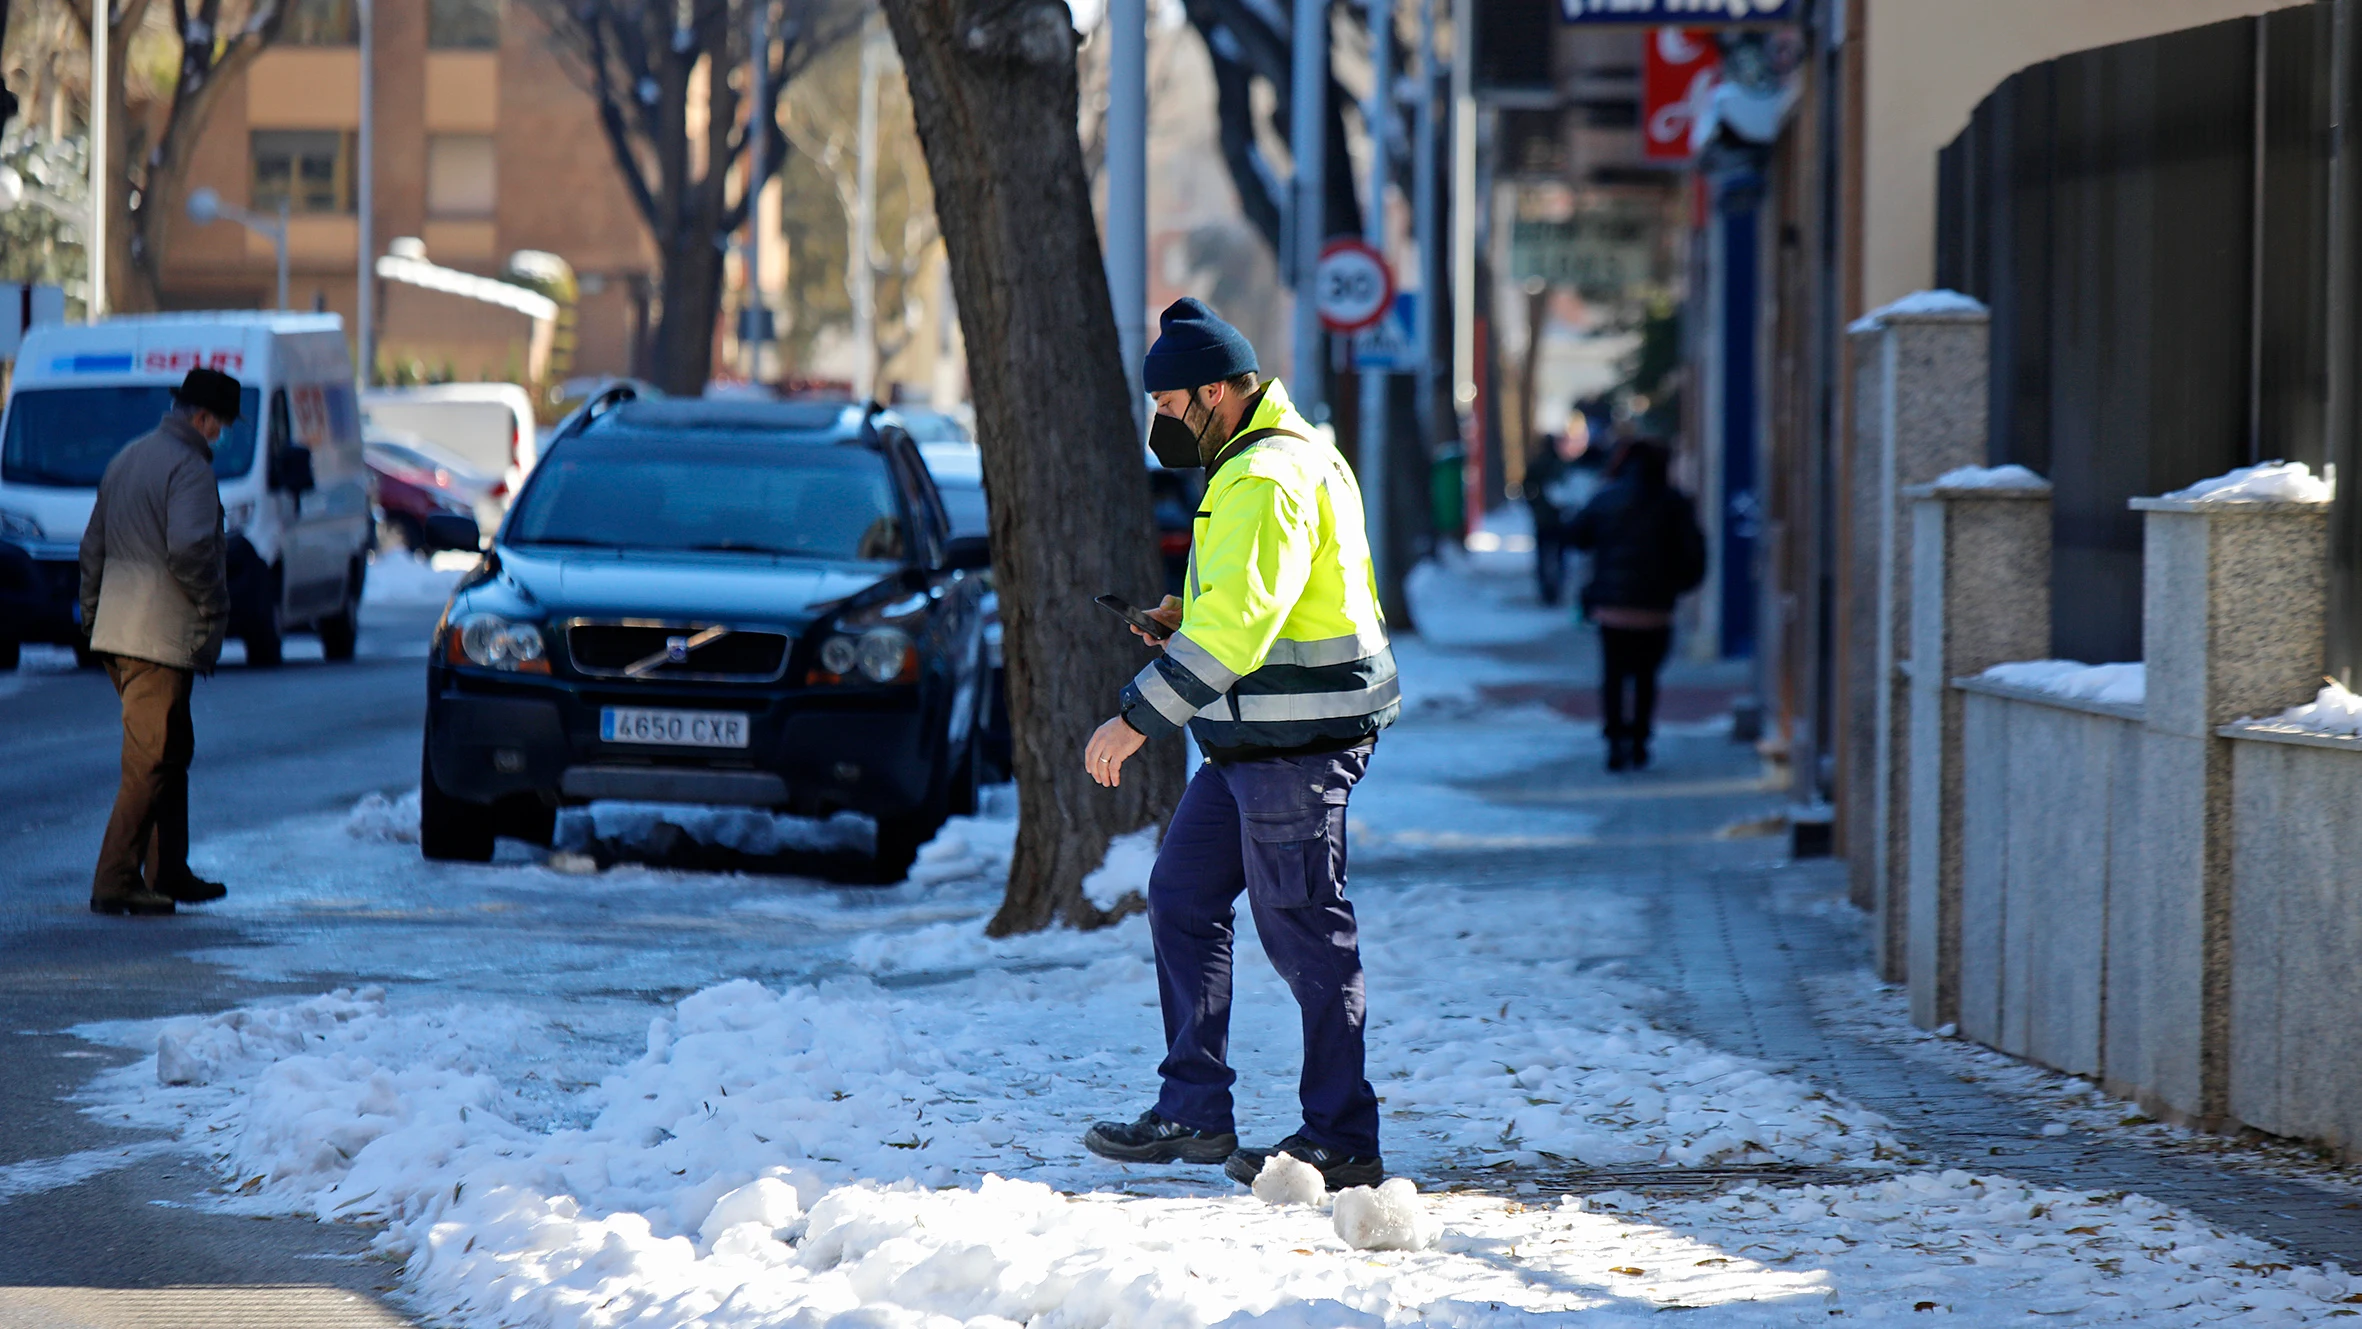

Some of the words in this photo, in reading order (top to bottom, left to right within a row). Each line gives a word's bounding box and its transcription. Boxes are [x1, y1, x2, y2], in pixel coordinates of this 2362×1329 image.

[1329, 269, 1377, 304] 30
[618, 712, 683, 741] 4650
[691, 718, 740, 745] CXR
